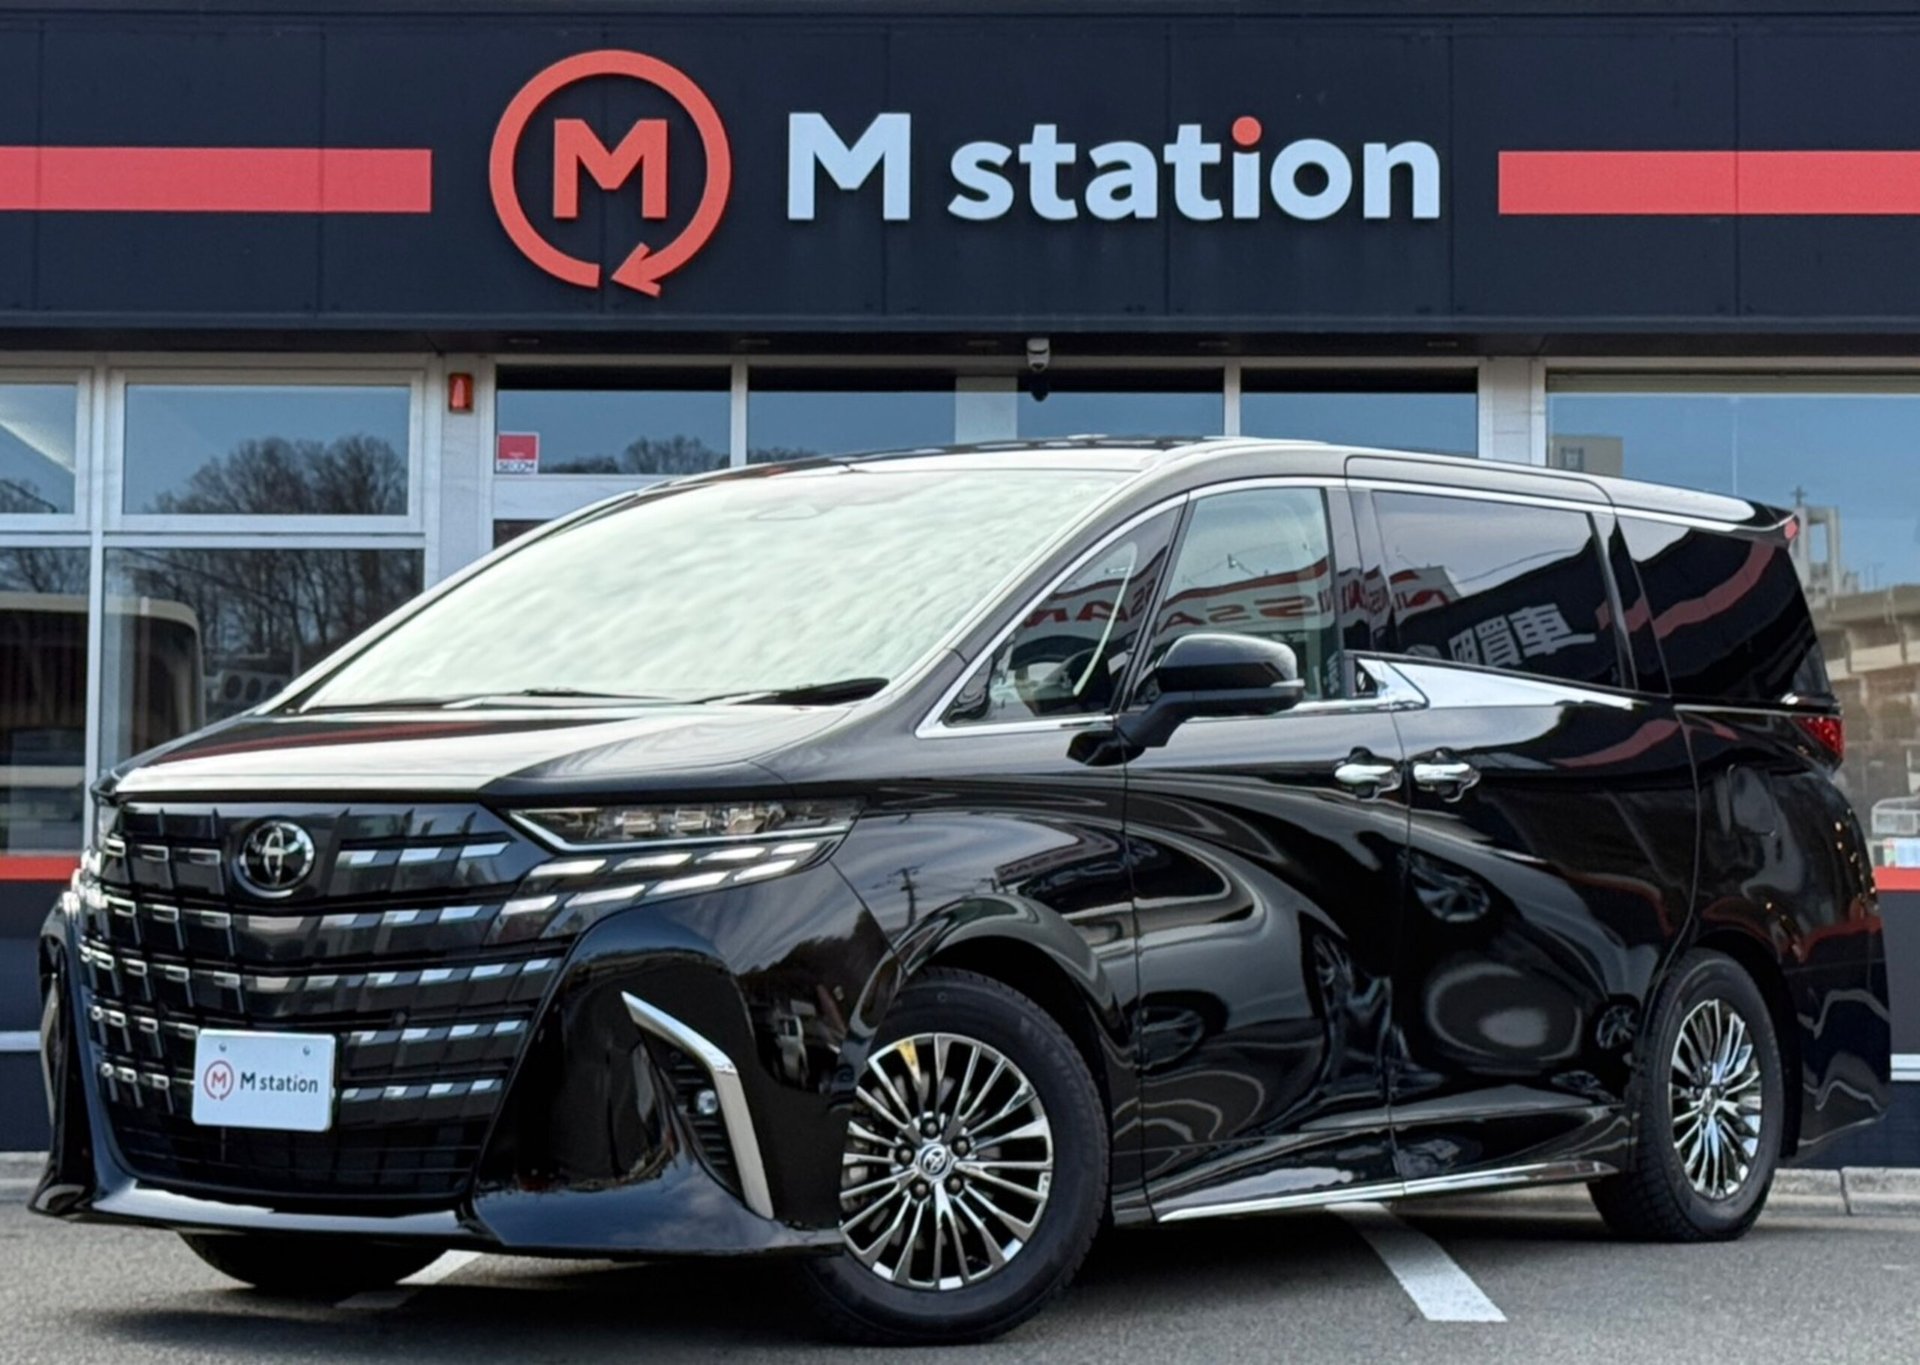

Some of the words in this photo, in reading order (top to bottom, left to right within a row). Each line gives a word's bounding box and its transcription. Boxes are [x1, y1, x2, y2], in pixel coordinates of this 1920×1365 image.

[553, 118, 667, 219] M
[789, 113, 910, 219] M
[949, 117, 1439, 219] station
[240, 1071, 256, 1091] M
[259, 1074, 318, 1094] station
